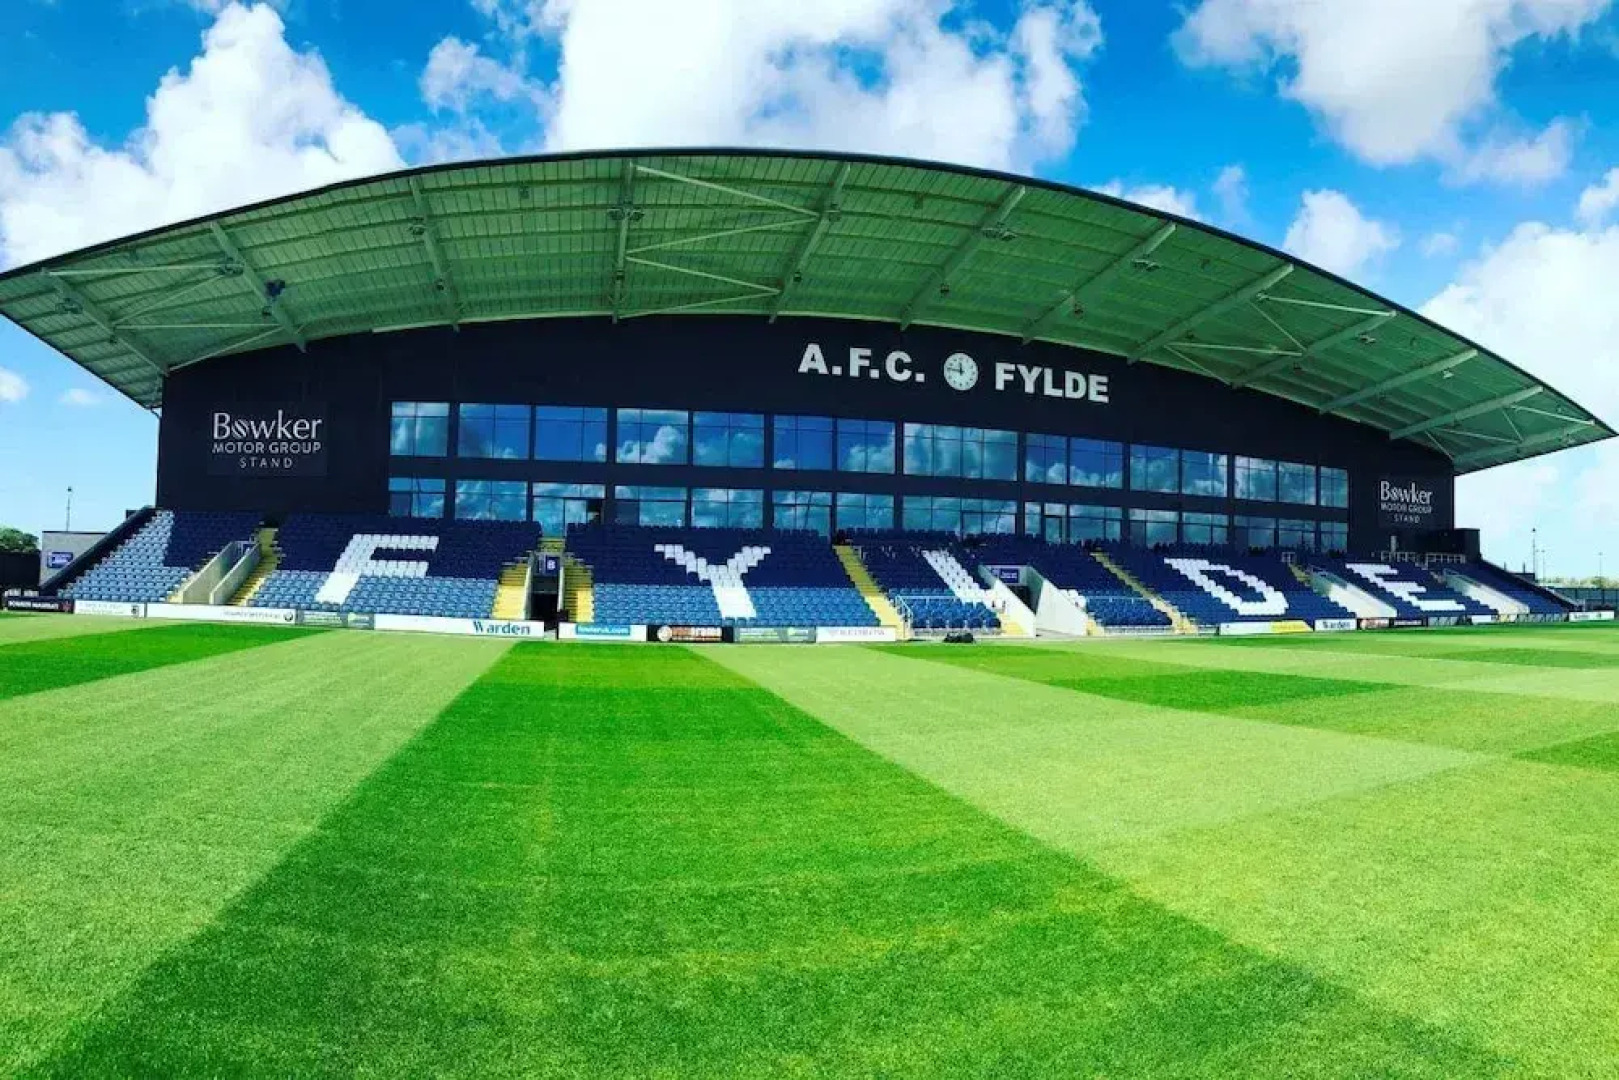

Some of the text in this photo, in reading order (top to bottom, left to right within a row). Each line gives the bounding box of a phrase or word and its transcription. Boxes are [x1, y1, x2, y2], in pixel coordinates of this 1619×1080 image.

[797, 343, 1110, 403] A.F.C. FYLDE
[213, 409, 322, 440] Bowker
[212, 441, 321, 454] MOTOR GROUP
[239, 456, 293, 468] STAND
[1380, 480, 1433, 504] Bowker
[1394, 513, 1420, 523] STAND
[473, 620, 530, 635] Warden
